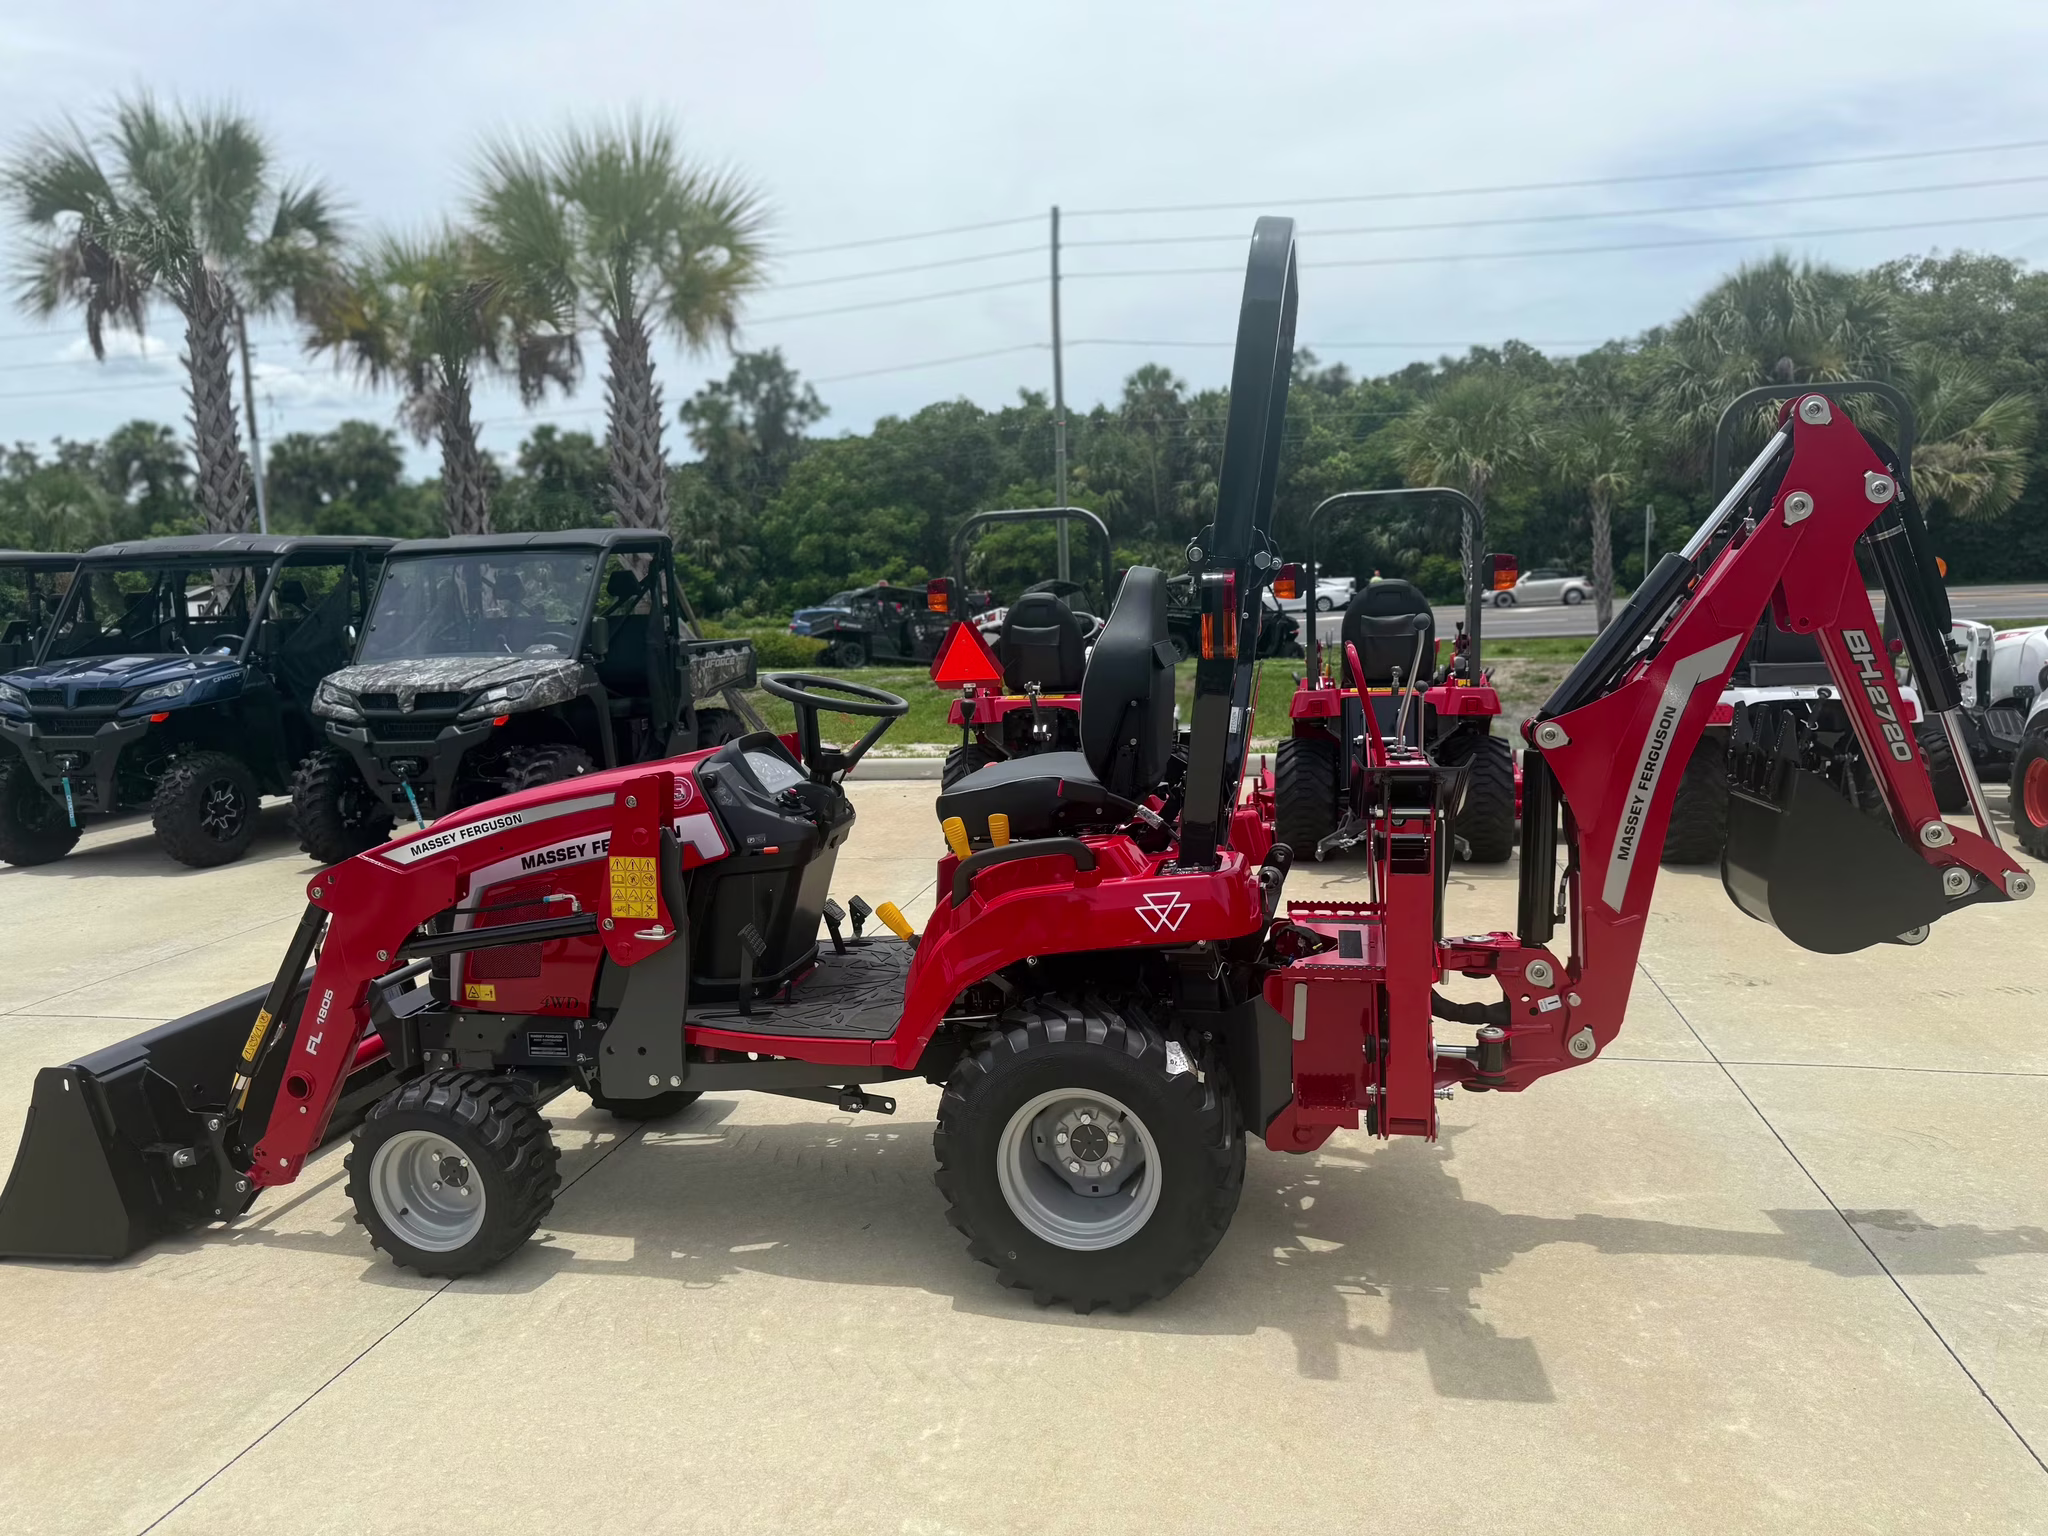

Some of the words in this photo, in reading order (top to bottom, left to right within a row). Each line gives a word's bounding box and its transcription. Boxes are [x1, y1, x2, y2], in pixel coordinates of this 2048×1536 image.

[212, 672, 240, 683] CFMOTO
[1617, 795, 1645, 861] MASSEY
[1638, 706, 1677, 791] FERGUSON
[410, 832, 456, 857] MASSEY
[459, 813, 523, 840] FERGUSON
[521, 843, 587, 870] MASSEY
[540, 994, 579, 1009] 4WD
[305, 1031, 323, 1056] FL
[316, 988, 334, 1025] 1805
